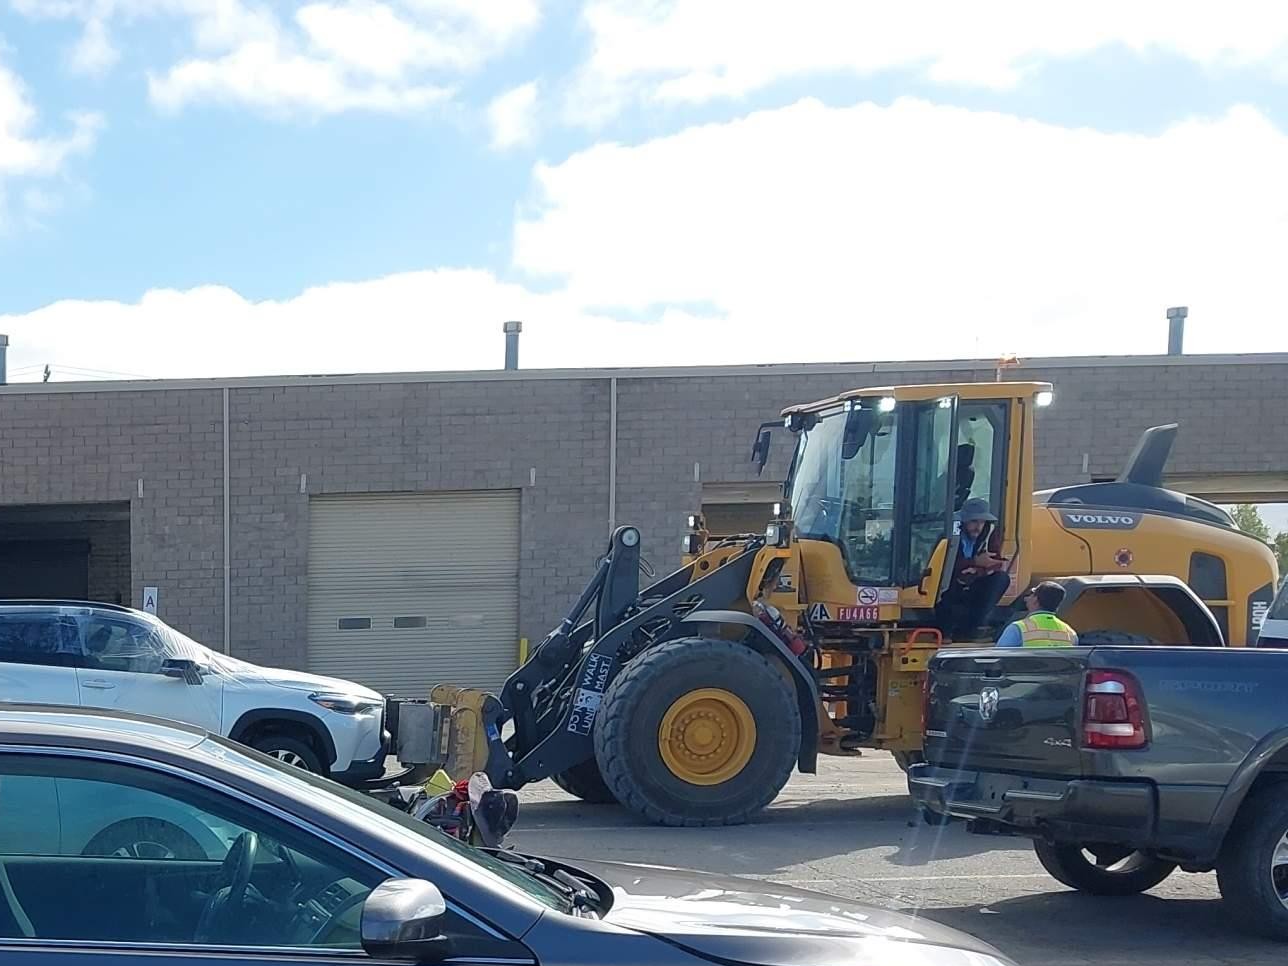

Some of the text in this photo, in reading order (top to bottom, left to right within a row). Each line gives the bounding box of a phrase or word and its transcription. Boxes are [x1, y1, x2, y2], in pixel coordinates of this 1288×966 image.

[1066, 514, 1134, 525] VOLVO
[839, 607, 879, 620] FU4A66
[582, 654, 600, 686] WALK
[595, 660, 609, 690] MAST
